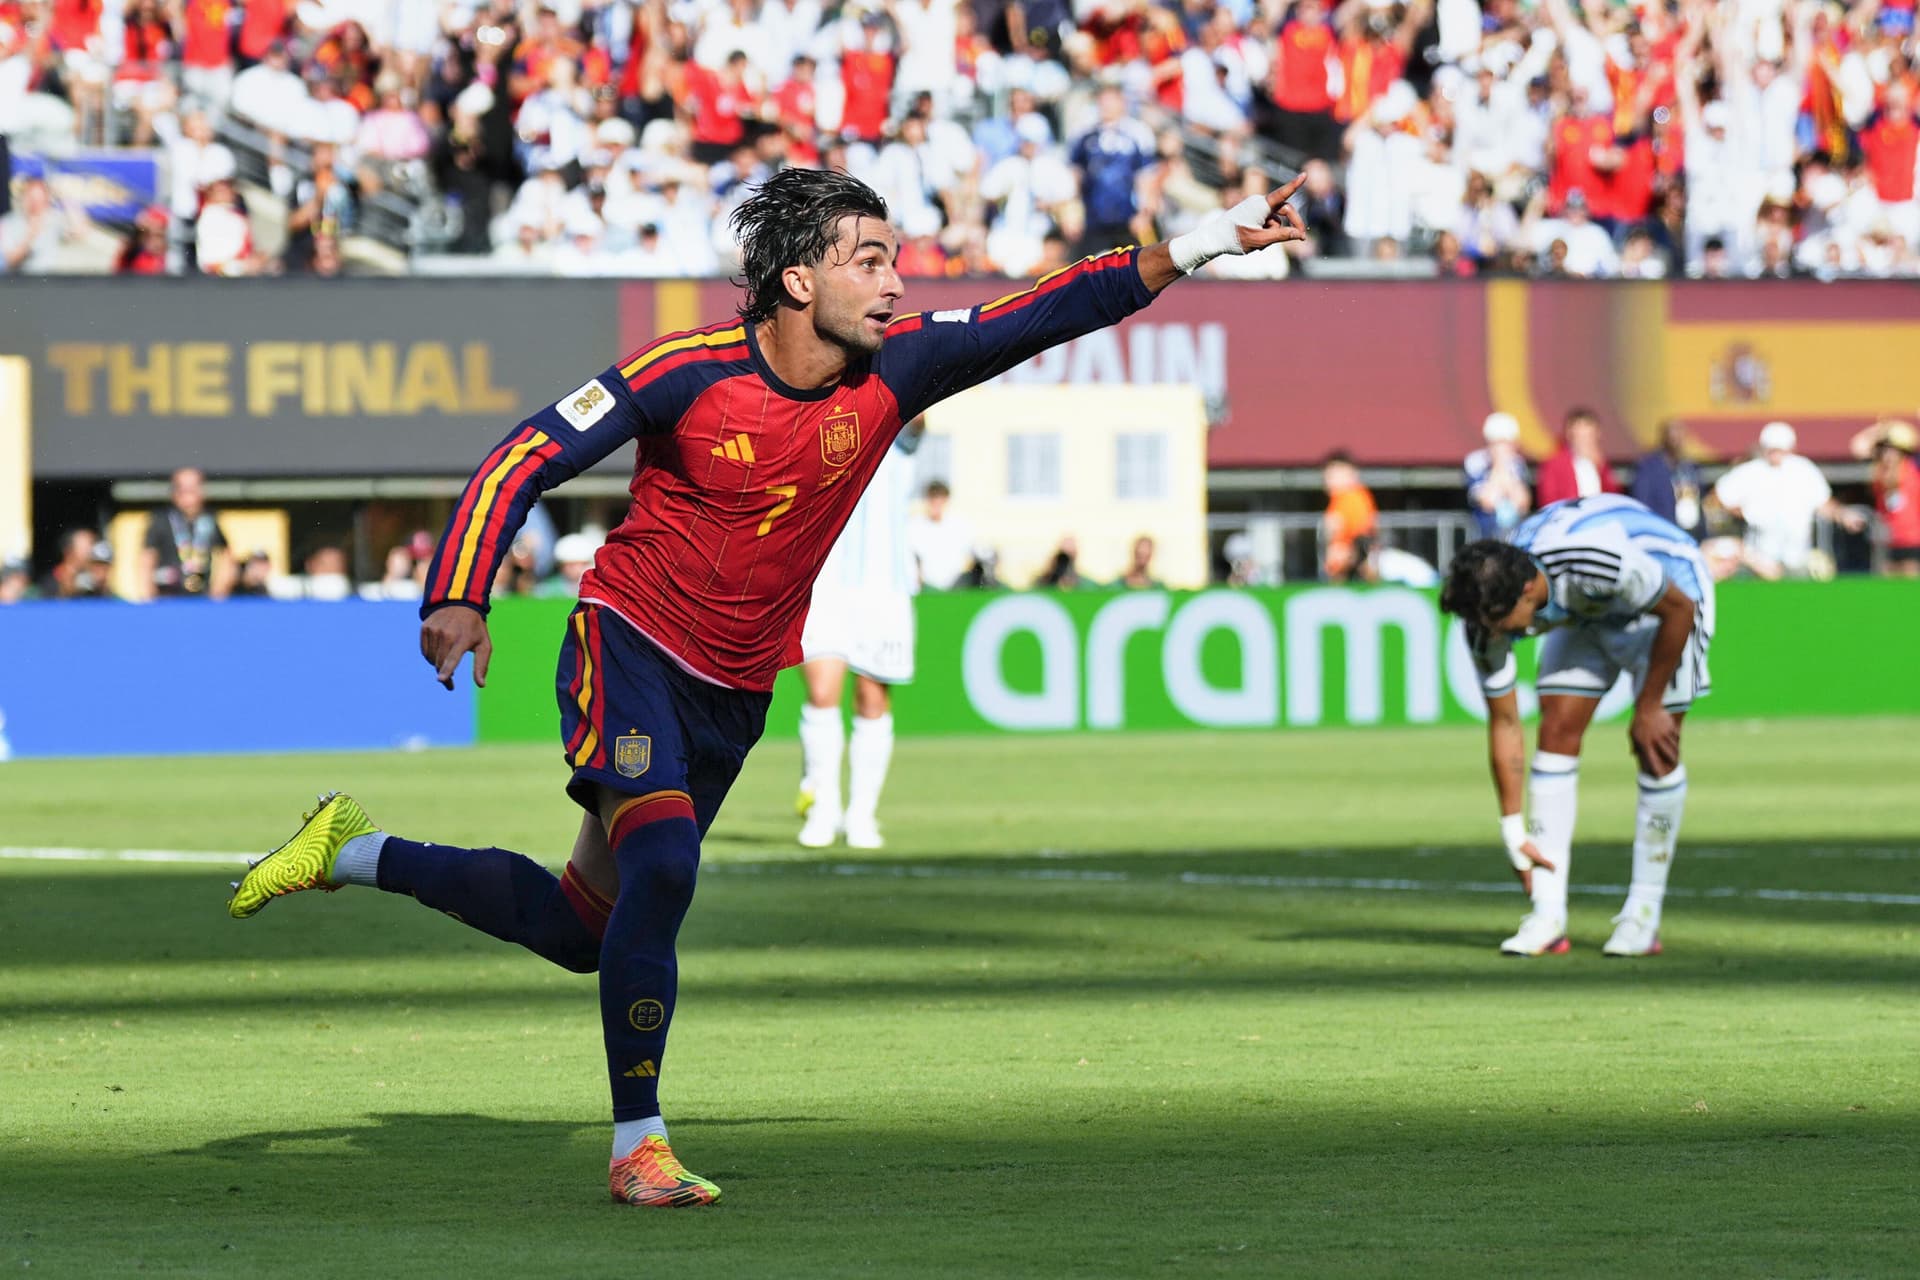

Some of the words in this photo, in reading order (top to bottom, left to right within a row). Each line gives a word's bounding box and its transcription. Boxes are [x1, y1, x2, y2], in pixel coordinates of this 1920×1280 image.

[48, 343, 230, 415] THE
[246, 343, 517, 415] FINAL
[985, 322, 1227, 405] AIN
[757, 486, 797, 537] 7
